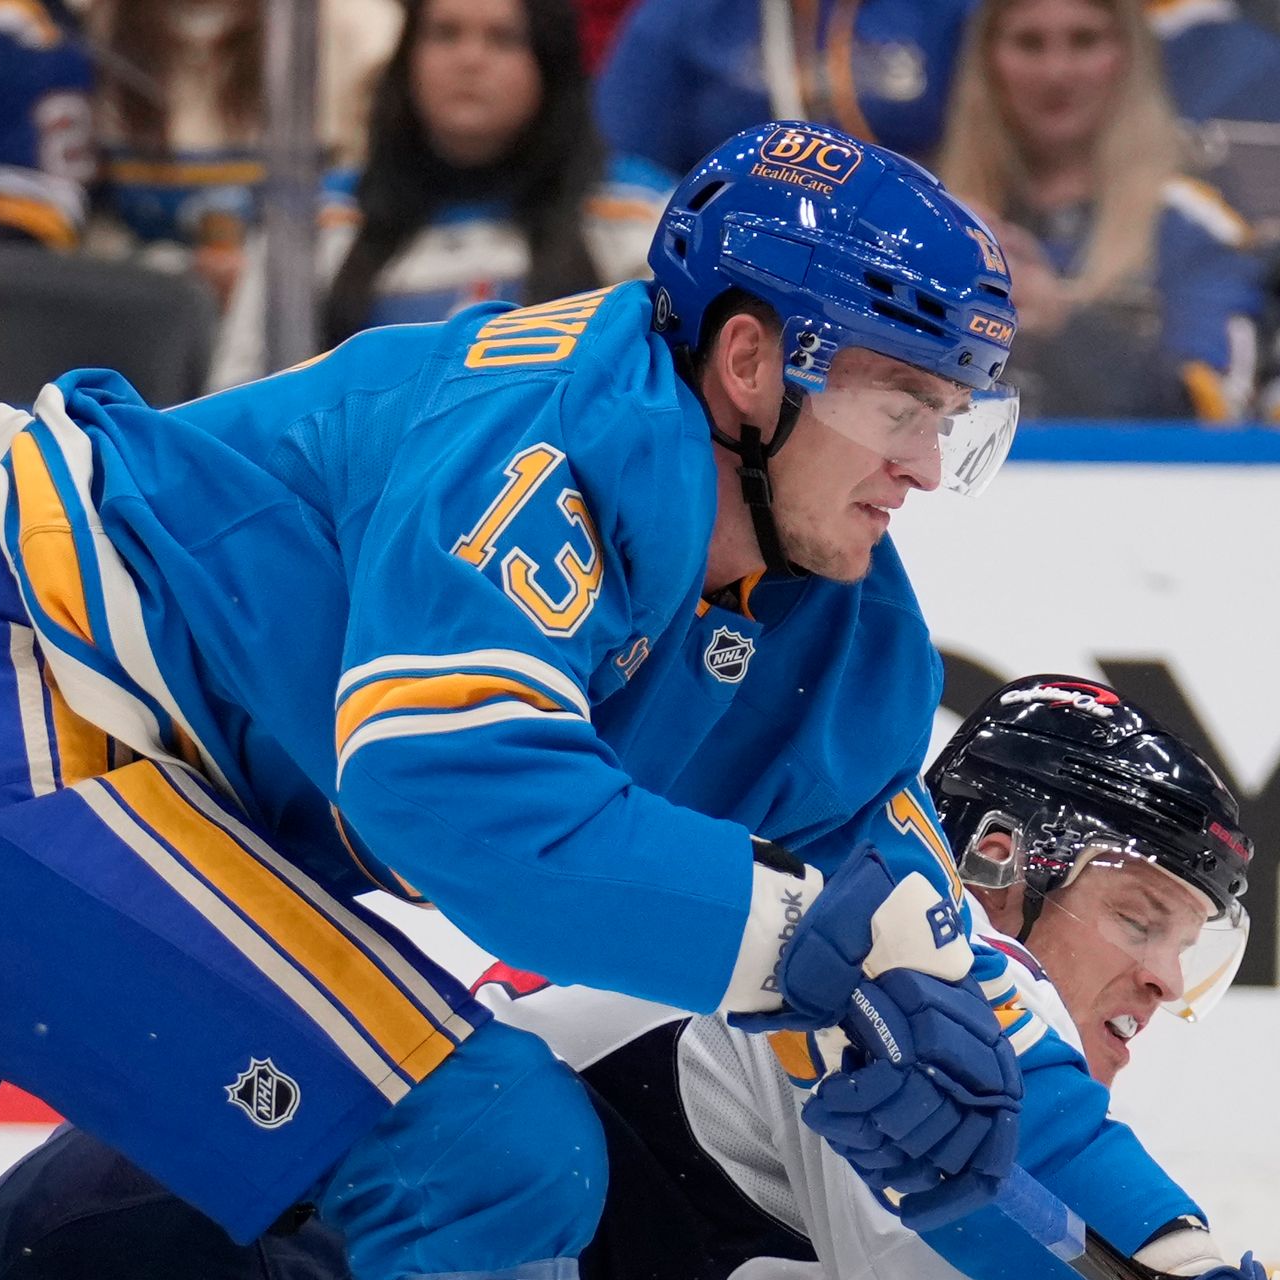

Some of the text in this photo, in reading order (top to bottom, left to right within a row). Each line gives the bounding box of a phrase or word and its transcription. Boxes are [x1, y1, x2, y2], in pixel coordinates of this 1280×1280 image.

[769, 132, 852, 172] BJC
[750, 162, 834, 195] HealthCare
[969, 314, 1014, 342] CCM
[448, 441, 604, 639] 13
[712, 648, 744, 666] NHL
[851, 987, 903, 1064] TOROPCHENKO
[257, 1075, 273, 1119] NHL
